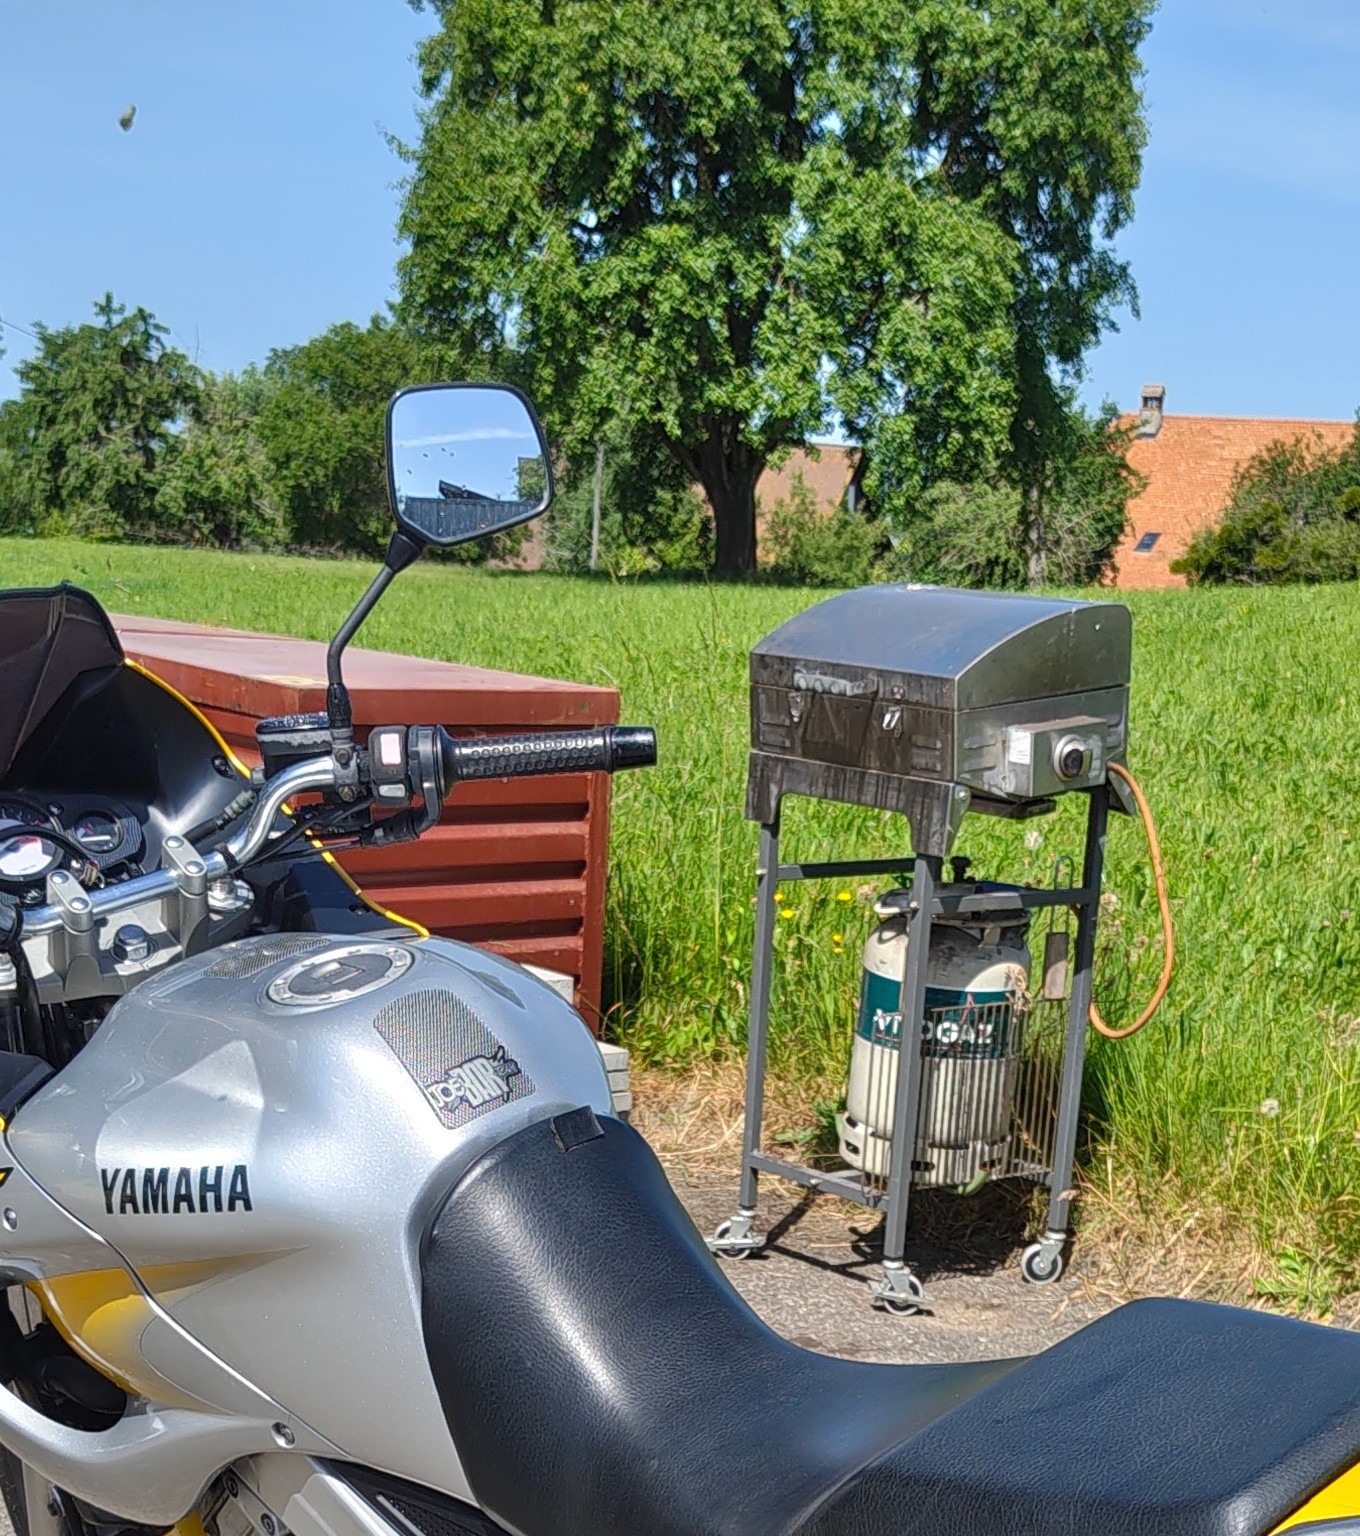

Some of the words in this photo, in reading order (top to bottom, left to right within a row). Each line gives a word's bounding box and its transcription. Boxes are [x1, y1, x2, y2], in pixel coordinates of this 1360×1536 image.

[428, 1079, 465, 1107] JOE
[448, 1058, 510, 1107] BAR
[101, 1164, 253, 1214] YAMAHA
